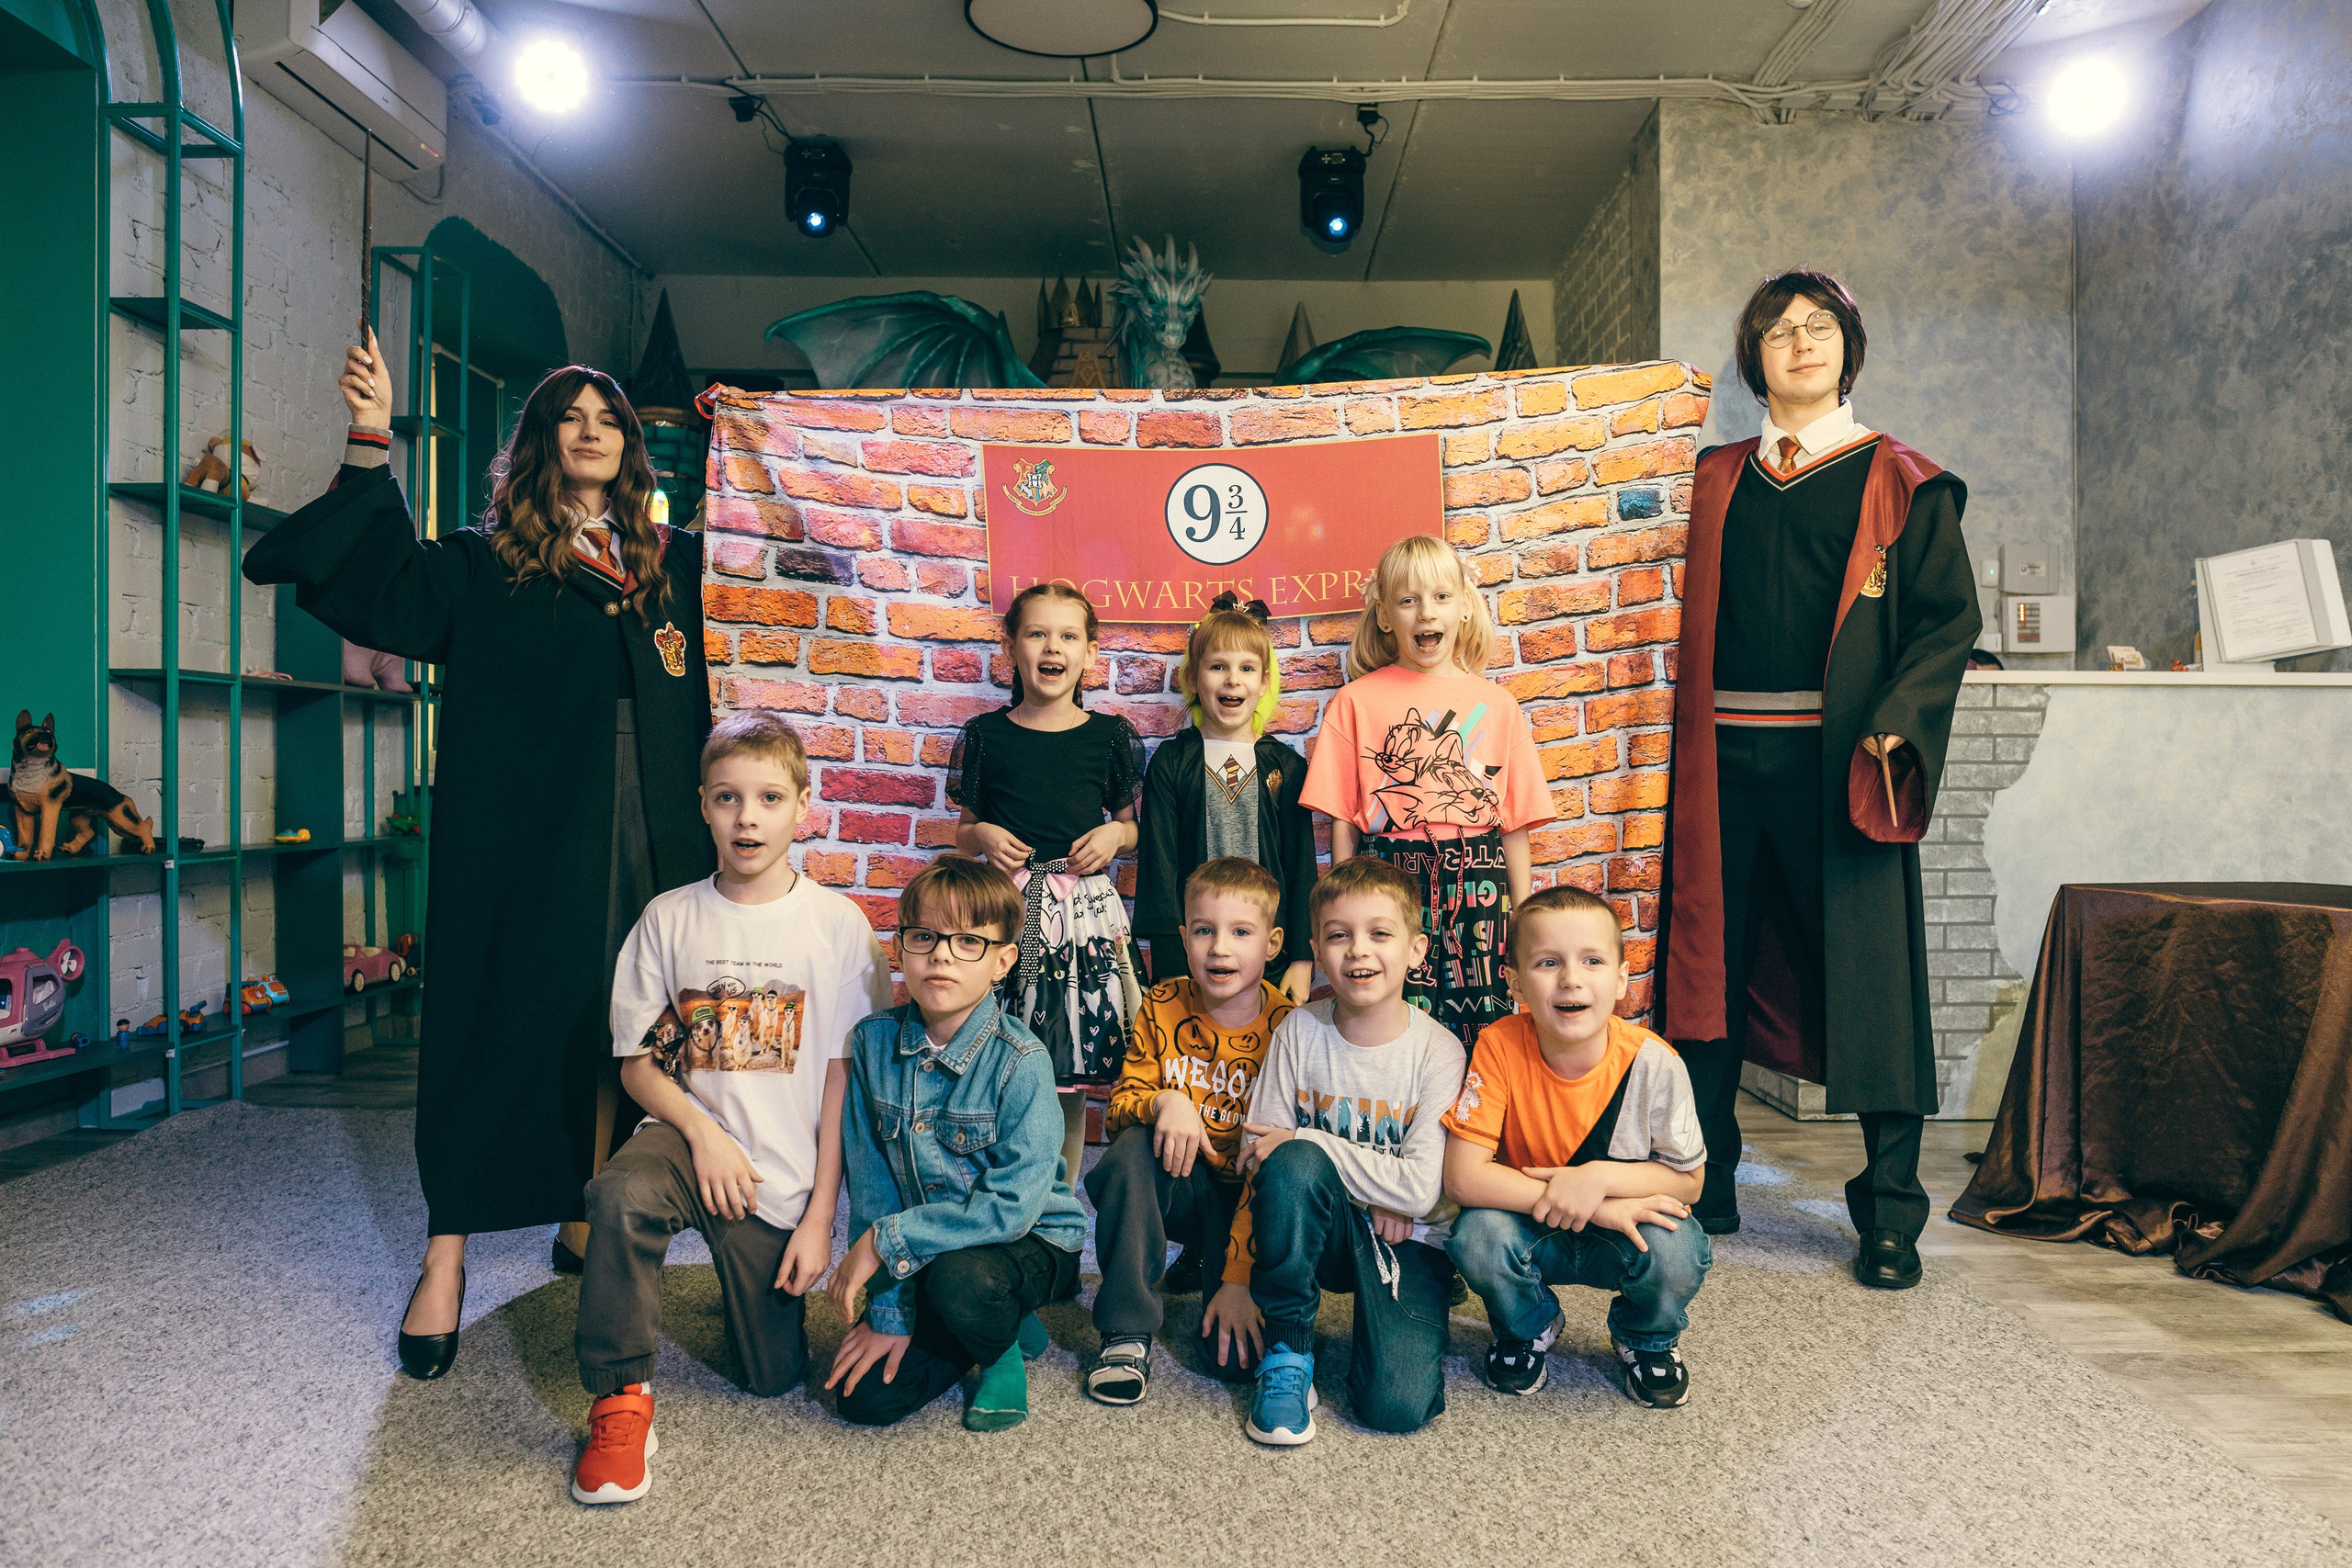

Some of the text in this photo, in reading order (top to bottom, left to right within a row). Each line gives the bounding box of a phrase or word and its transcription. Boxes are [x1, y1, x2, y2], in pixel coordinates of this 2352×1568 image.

[1182, 483, 1222, 543] 9
[1268, 568, 1377, 606] EXPR
[1198, 1103, 1217, 1119] THE
